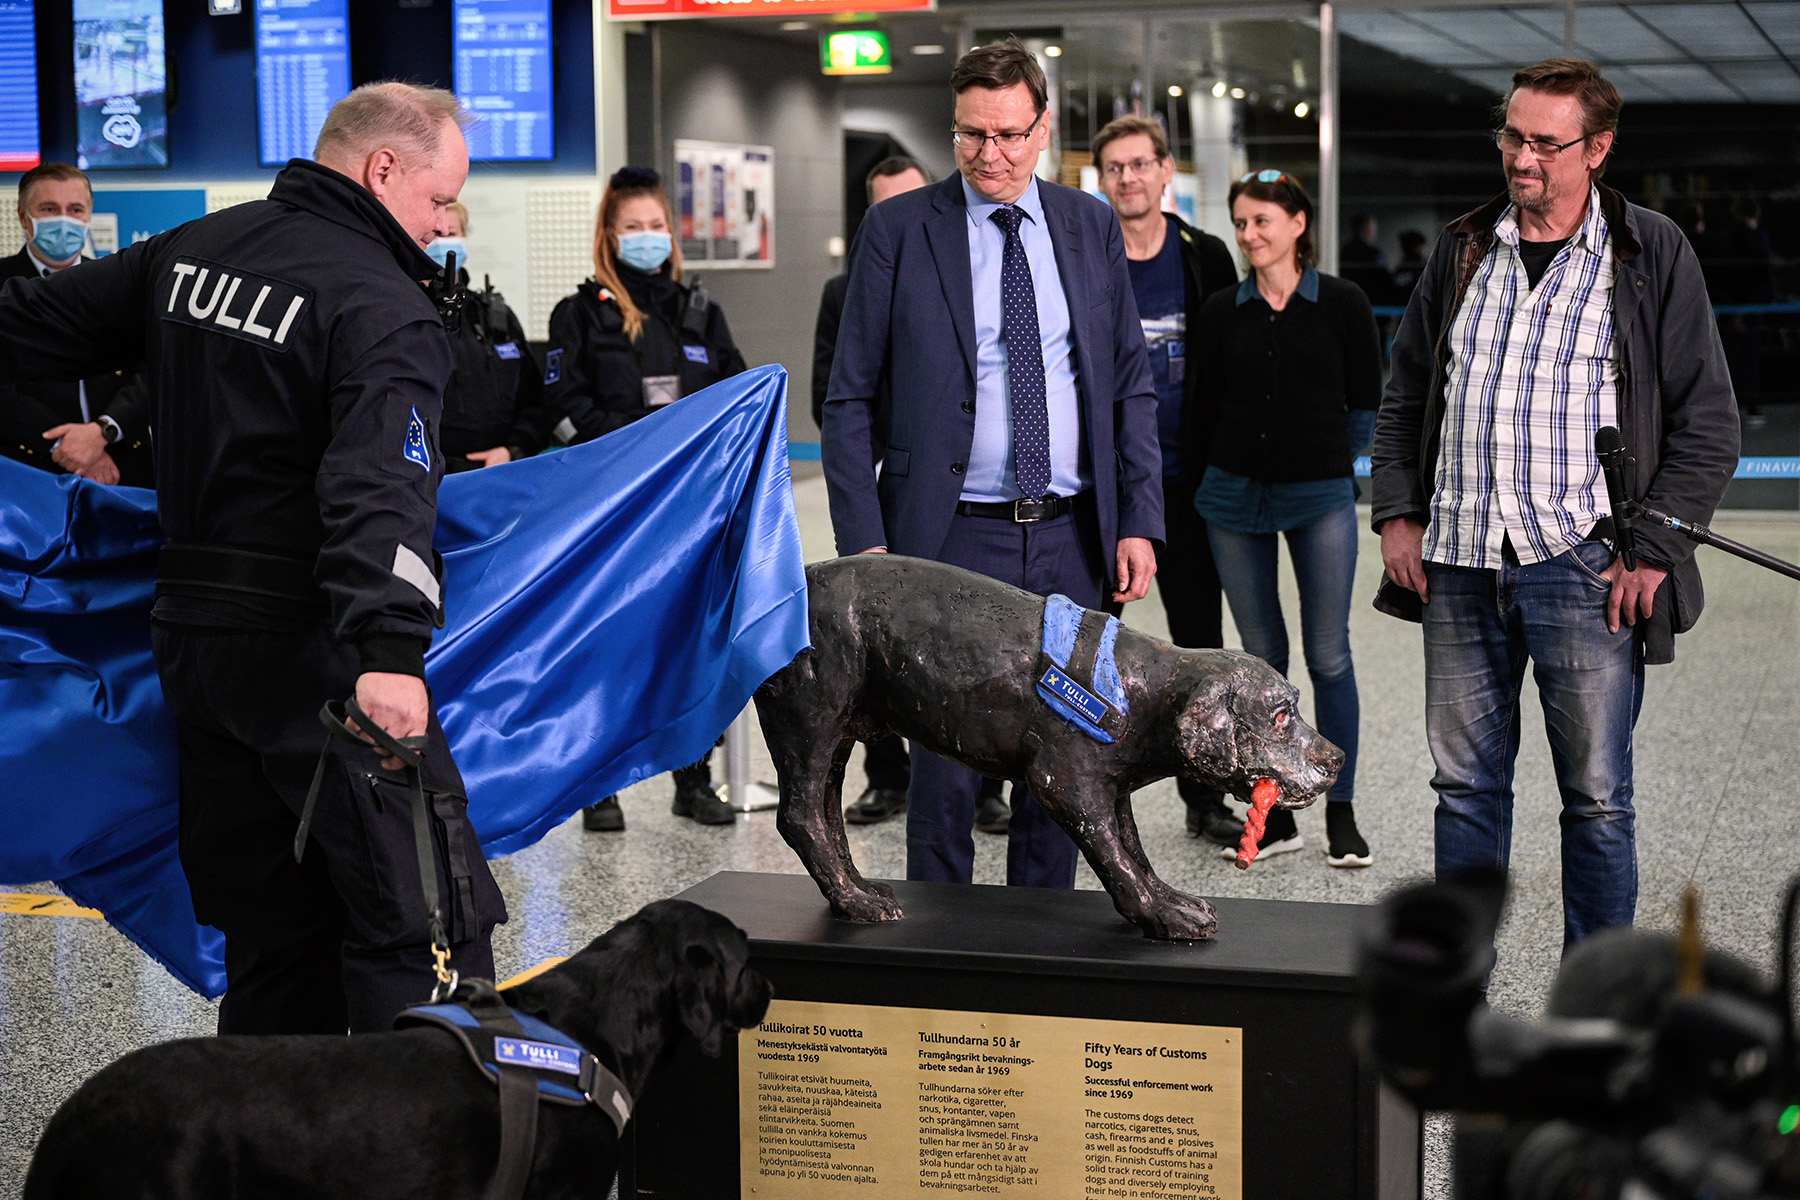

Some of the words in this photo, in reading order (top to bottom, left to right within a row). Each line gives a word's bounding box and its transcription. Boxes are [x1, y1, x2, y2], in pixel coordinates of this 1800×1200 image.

[167, 262, 305, 344] TULLI
[1062, 681, 1089, 706] TULLI
[759, 1022, 810, 1035] Tullikoirat
[813, 1025, 827, 1036] 50
[829, 1028, 863, 1038] vuotta
[757, 1039, 829, 1052] Menestyksekästä
[829, 1044, 888, 1056] valvontatyötä
[918, 1031, 989, 1046] Tullhundarna
[992, 1036, 1006, 1047] 50
[1009, 1037, 1021, 1048] år
[520, 1043, 559, 1061] TULLI
[758, 1052, 795, 1061] vuodesta
[797, 1053, 820, 1063] 1969
[918, 1049, 980, 1063] Framgångsrikt
[982, 1053, 1035, 1067] bevaknings-
[1084, 1042, 1111, 1056] Fifty
[1113, 1044, 1143, 1056] Years
[1145, 1046, 1157, 1057] of
[1160, 1047, 1207, 1060] Customs
[918, 1062, 946, 1072] arbete
[948, 1064, 974, 1073] sedan
[976, 1065, 985, 1074] år
[987, 1066, 1010, 1075] 1969
[1084, 1057, 1113, 1072] Dogs
[758, 1071, 799, 1082] Tullikoirat
[800, 1075, 828, 1084] etsivät
[830, 1076, 872, 1088] huumeita,
[1084, 1075, 1130, 1087] Successful
[1132, 1079, 1189, 1091] enforcement
[1191, 1083, 1213, 1092] work
[758, 1083, 803, 1094] savukkeita,
[806, 1086, 843, 1097] nuuskaa,
[845, 1088, 878, 1098] käteistä
[919, 1082, 976, 1094] Tullhundarna
[977, 1086, 1001, 1096] söker
[1003, 1088, 1024, 1097] efter
[1084, 1088, 1108, 1098] since
[1110, 1089, 1133, 1099] 1969
[758, 1093, 784, 1103] rahaa,
[786, 1095, 811, 1104] aseita
[811, 1096, 820, 1106] ja
[822, 1097, 882, 1109] räjähdeaineita
[919, 1094, 961, 1105] narkotika,
[963, 1096, 1007, 1108] cigaretter,
[759, 1103, 778, 1113] sekä
[779, 1106, 831, 1117] eläinperäisiä
[919, 1106, 941, 1114] snus,
[943, 1106, 987, 1117] kontanter,
[989, 1110, 1015, 1120] vapen
[1085, 1109, 1101, 1118] The
[1103, 1111, 1140, 1121] customs
[1142, 1112, 1164, 1124] dogs
[1166, 1114, 1194, 1125] detect
[759, 1114, 818, 1126] elintarvikkeita.
[820, 1118, 855, 1129] Suomen
[919, 1115, 935, 1124] och
[937, 1116, 996, 1128] sprängämnen
[998, 1121, 1020, 1130] samt
[1085, 1120, 1127, 1132] narcotics,
[1129, 1123, 1174, 1135] cigarettes,
[1176, 1128, 1200, 1137] snus,
[759, 1125, 784, 1135] tullilla
[798, 1128, 827, 1138] vankka
[829, 1130, 868, 1141] kokemus
[919, 1126, 964, 1137] animaliska
[966, 1129, 1009, 1140] livsmedel.
[1011, 1132, 1039, 1142] Finska
[1085, 1132, 1108, 1141] cash,
[1109, 1132, 1147, 1143] firearms
[1148, 1136, 1166, 1145] and
[759, 1135, 788, 1145] koirien
[790, 1138, 855, 1150] kouluttamisesta
[919, 1137, 944, 1146] tullen
[946, 1138, 960, 1147] har
[962, 1141, 979, 1149] mer
[981, 1140, 993, 1149] än
[995, 1142, 1006, 1150] 50
[1007, 1142, 1016, 1151] år
[1018, 1144, 1029, 1152] av
[759, 1146, 767, 1155] ja
[769, 1148, 831, 1159] monipuolisesta
[919, 1147, 953, 1158] gedigen
[955, 1150, 1000, 1161] erfarenhet
[1002, 1154, 1013, 1162] av
[1014, 1155, 1027, 1163] att
[1085, 1143, 1095, 1151] as
[1096, 1143, 1115, 1152] well
[1116, 1145, 1127, 1153] as
[1129, 1145, 1174, 1157] foodstuffs
[1175, 1148, 1186, 1157] of
[1187, 1150, 1218, 1160] animal
[760, 1157, 829, 1170] hyödyntämisestä
[831, 1162, 874, 1173] valvonnan
[919, 1158, 942, 1167] skola
[943, 1159, 974, 1170] hundar
[977, 1162, 993, 1171] och
[994, 1164, 1003, 1172] ta
[1005, 1164, 1027, 1175] hjälp
[1028, 1167, 1039, 1175] av
[1085, 1154, 1113, 1164] origin.
[1115, 1155, 1146, 1165] Finnish
[1148, 1157, 1188, 1169] Customs
[1189, 1160, 1206, 1170] has
[1207, 1162, 1213, 1170] a
[760, 1168, 786, 1177] apuna
[787, 1169, 795, 1178] jo
[797, 1170, 807, 1179] yli
[809, 1171, 819, 1179] 50
[820, 1172, 852, 1182] vuoden
[853, 1174, 879, 1184] ajalta.
[919, 1169, 939, 1178] dem
[941, 1170, 952, 1180] på
[953, 1172, 966, 1180] ett
[967, 1172, 1015, 1184] mångsidigt
[1016, 1176, 1033, 1185] sätt
[1034, 1176, 1038, 1185] i
[1085, 1164, 1106, 1173] solid
[1108, 1166, 1130, 1175] track
[1132, 1169, 1161, 1178] record
[1163, 1170, 1173, 1178] of
[1174, 1171, 1210, 1183] training
[919, 1179, 1001, 1194] bevakningsarbetet.
[1085, 1175, 1107, 1186] dogs
[1108, 1177, 1126, 1186] and
[1127, 1178, 1167, 1191] diversely
[1168, 1182, 1216, 1194] employing
[1085, 1186, 1106, 1195] their
[1108, 1187, 1128, 1198] help
[1130, 1189, 1138, 1198] in
[1140, 1190, 1197, 1200] enforcement
